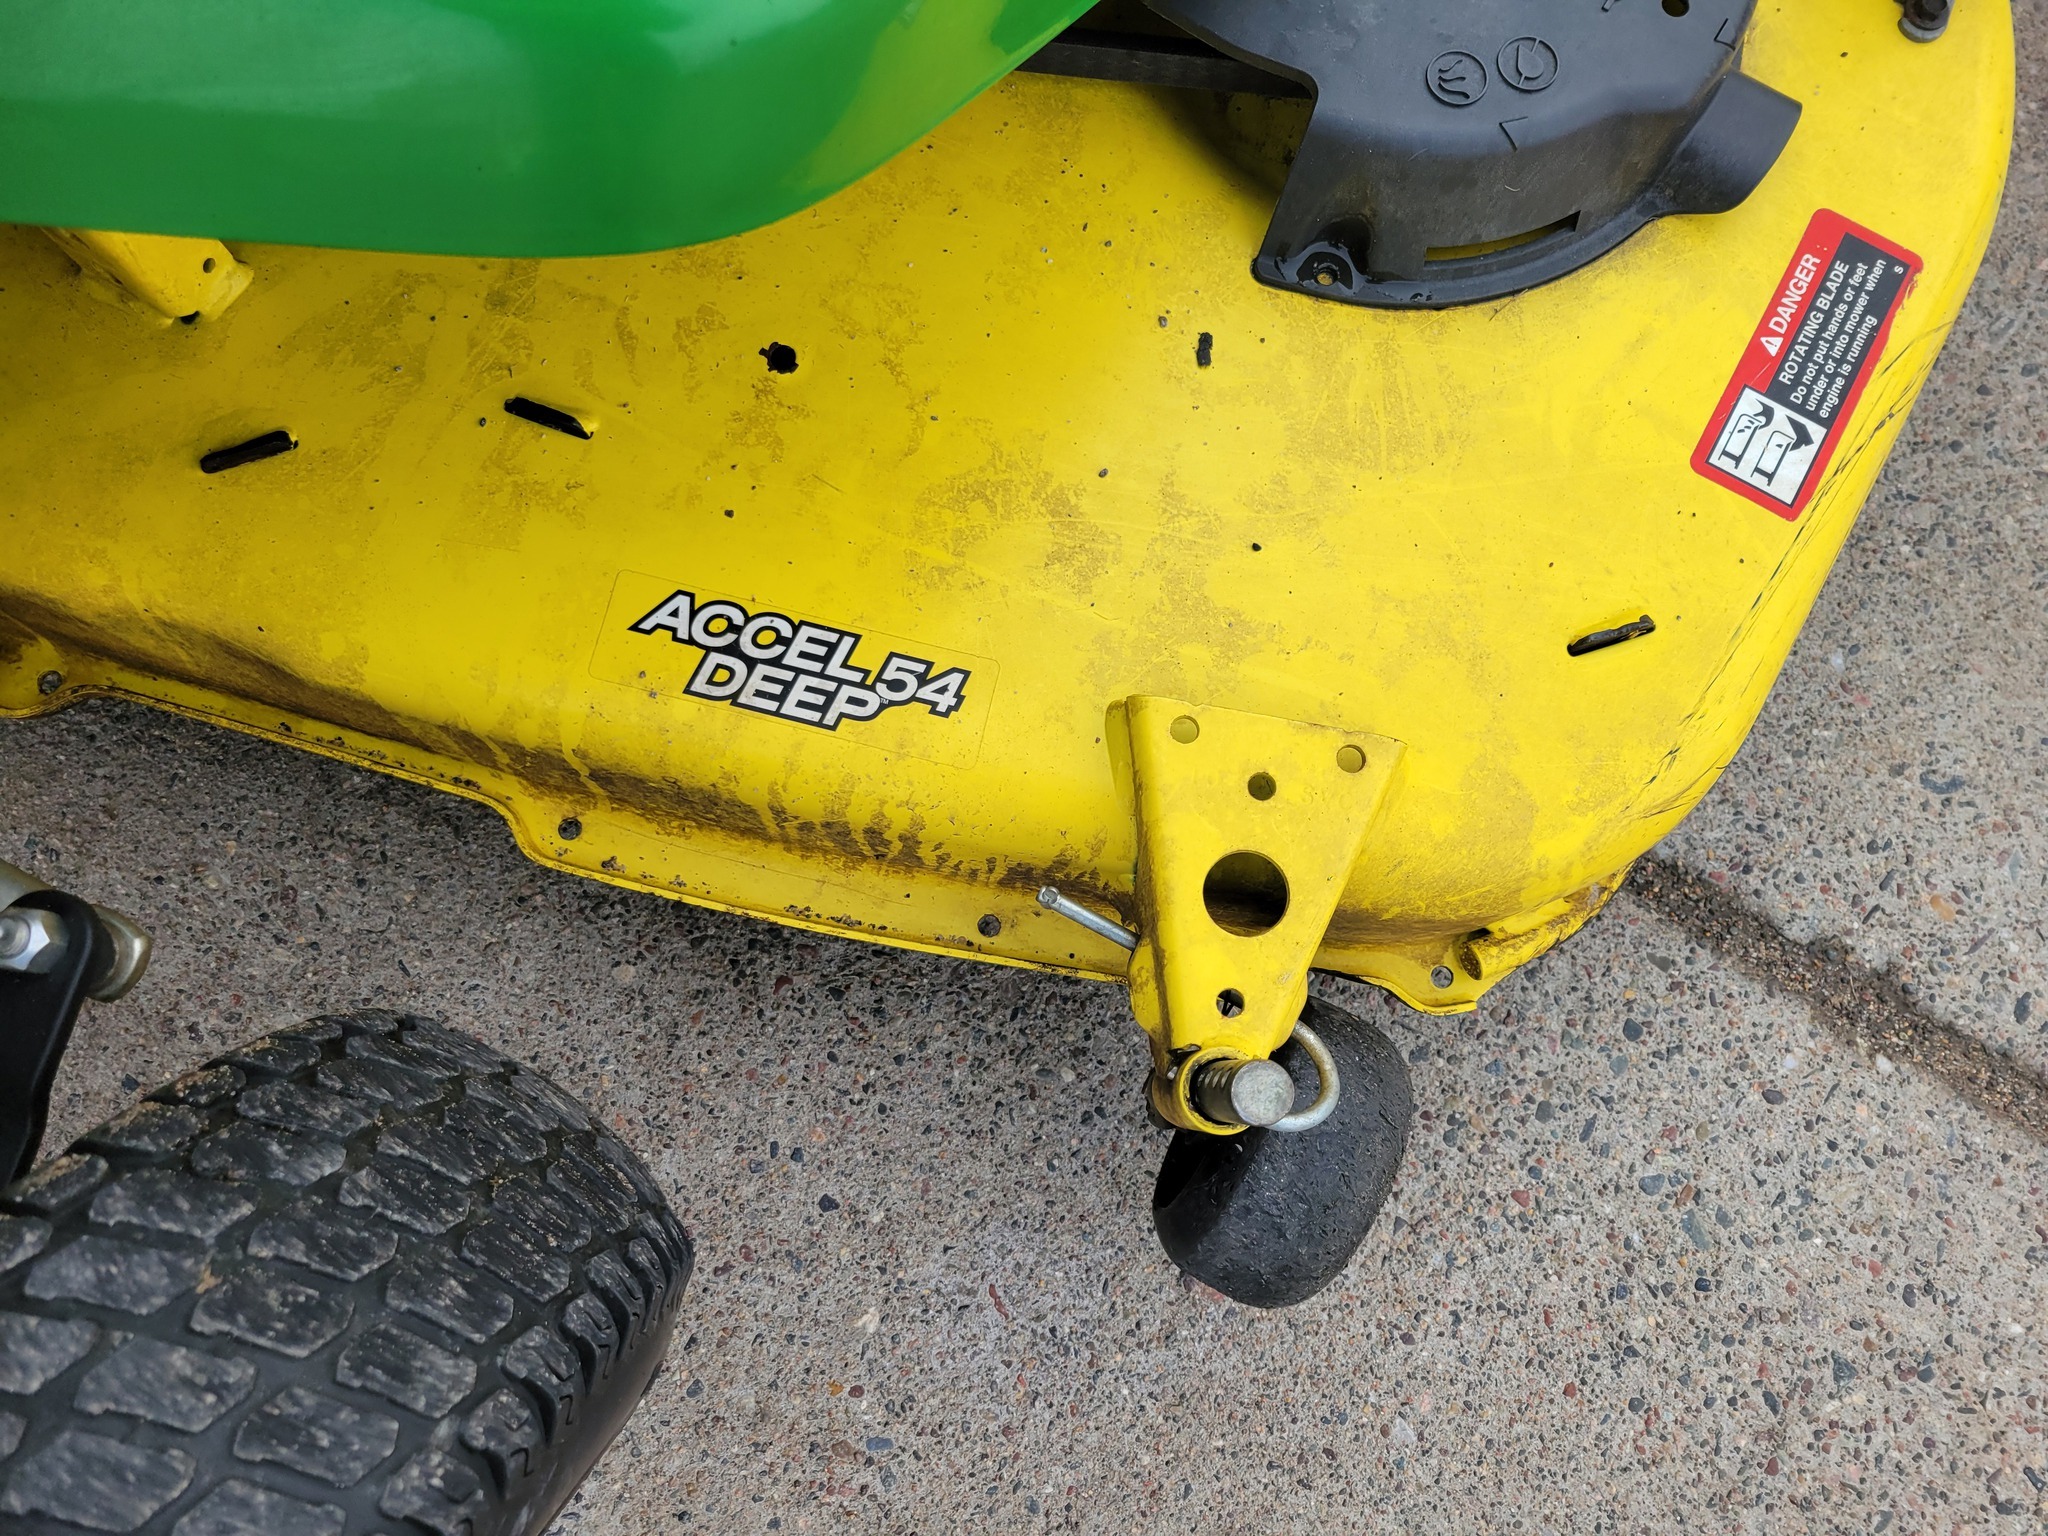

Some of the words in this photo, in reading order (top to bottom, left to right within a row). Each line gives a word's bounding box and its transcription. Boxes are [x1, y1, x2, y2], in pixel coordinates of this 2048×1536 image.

[1768, 253, 1821, 335] DANGER
[1843, 286, 1856, 302] or
[1848, 262, 1869, 287] feet
[1778, 310, 1825, 385] ROTATING
[1815, 260, 1850, 311] BLADE
[1805, 373, 1829, 411] under
[1821, 358, 1837, 374] or
[1829, 334, 1849, 359] into
[1843, 291, 1870, 334] mower
[1864, 259, 1887, 291] when
[1812, 340, 1832, 364] put
[1821, 302, 1849, 341] hands
[1789, 386, 1807, 405] Do
[1803, 362, 1819, 386] not
[1819, 376, 1845, 418] engine
[1837, 363, 1852, 376] is
[1846, 314, 1878, 363] running
[628, 590, 871, 683] ACCEL
[682, 650, 884, 731] DEEP
[872, 652, 972, 718] 54
